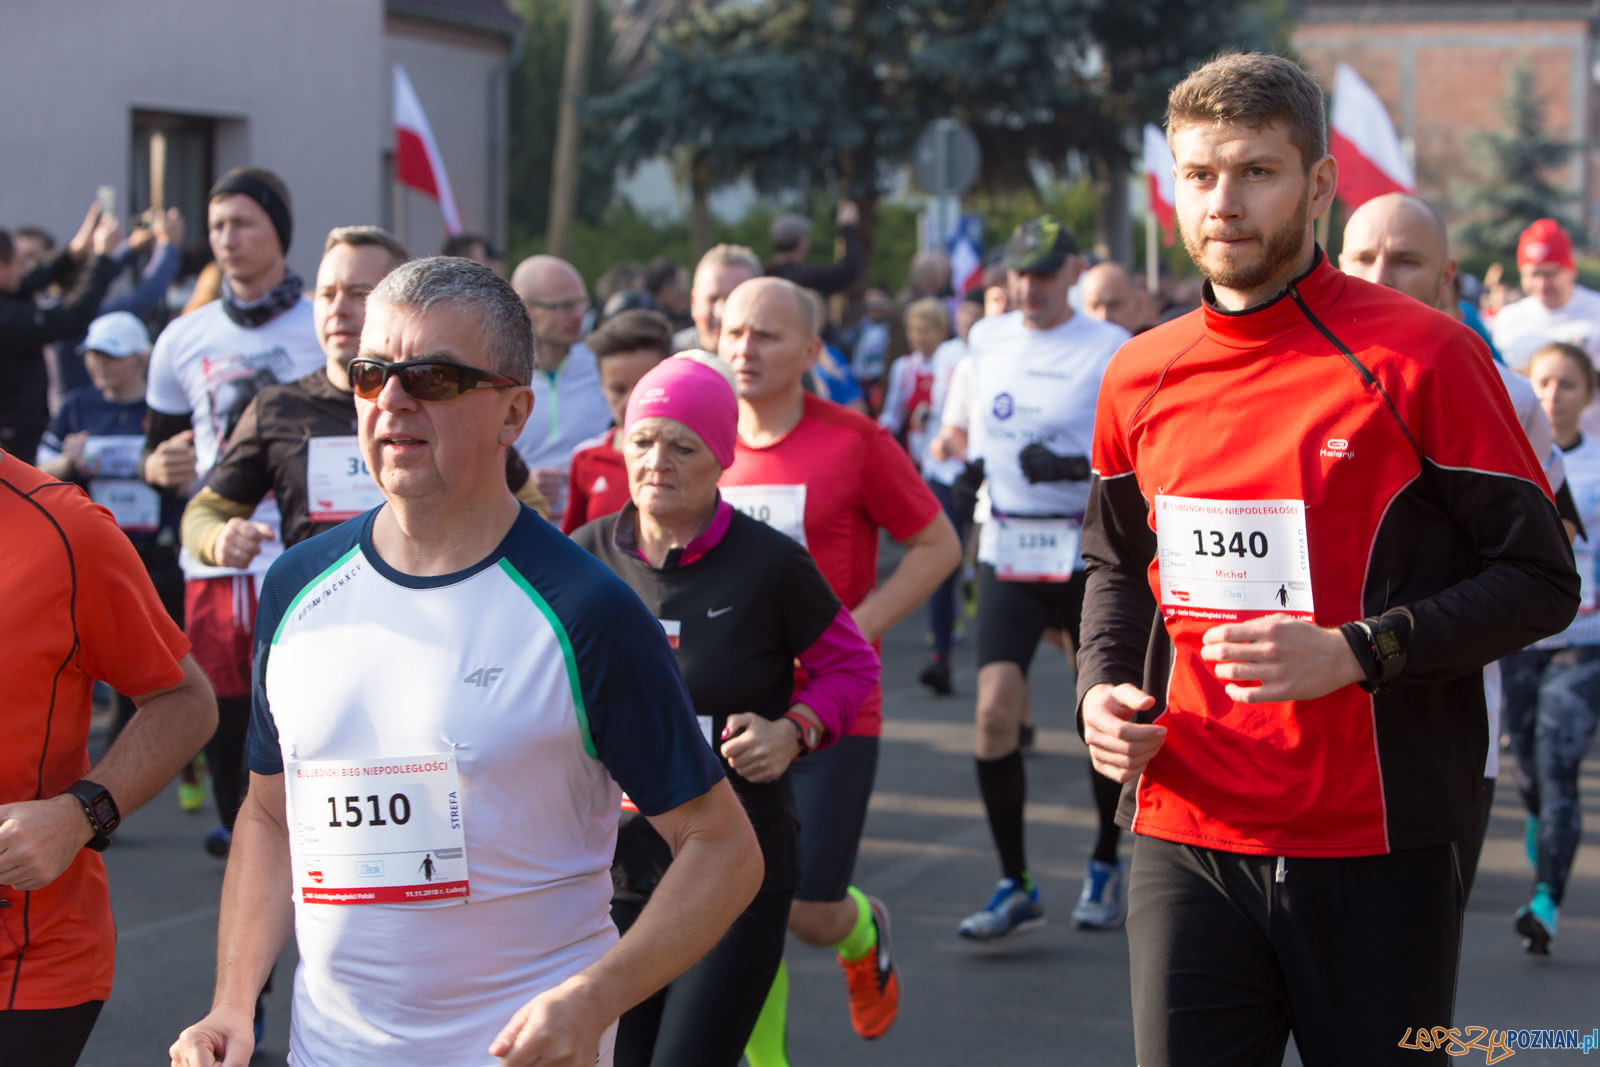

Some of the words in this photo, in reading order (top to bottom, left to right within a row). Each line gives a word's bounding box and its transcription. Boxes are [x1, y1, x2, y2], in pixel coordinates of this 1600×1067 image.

[1206, 507, 1224, 515] BIEG
[1225, 505, 1298, 515] NIEPODLEGŁOŚCI
[1193, 529, 1269, 559] 1340
[463, 667, 505, 688] 4F
[341, 767, 361, 777] BIEG
[363, 761, 448, 776] NIEPODLEGŁOŚCI
[328, 793, 411, 828] 1510
[449, 791, 461, 830] STREFA
